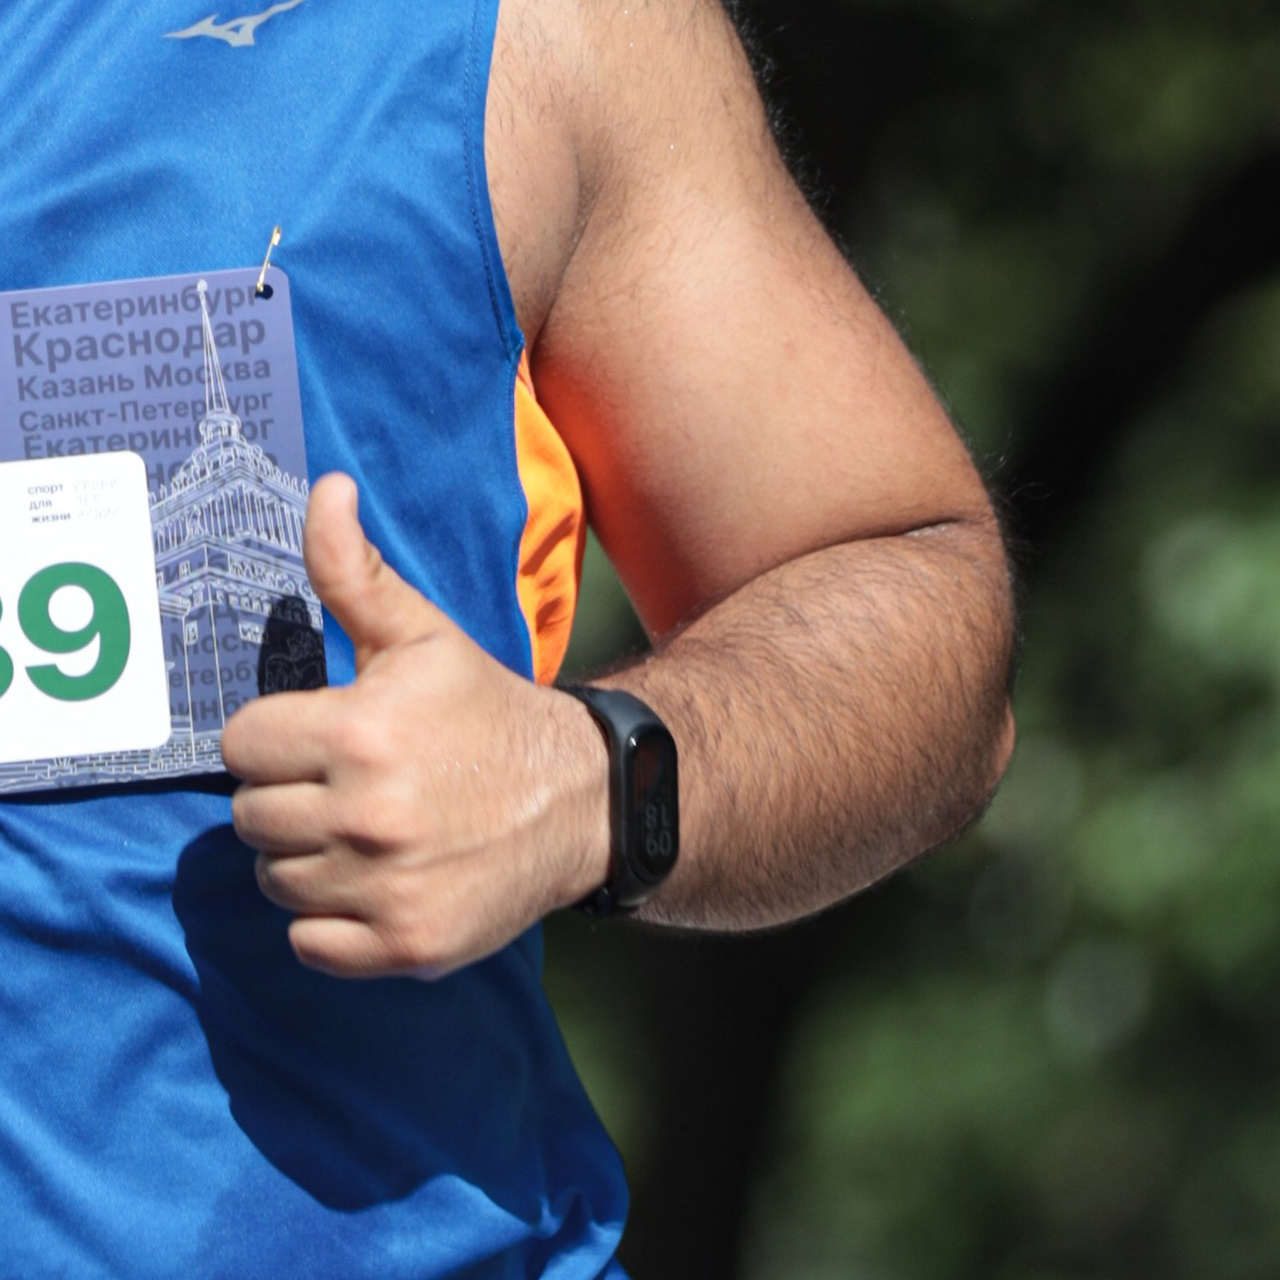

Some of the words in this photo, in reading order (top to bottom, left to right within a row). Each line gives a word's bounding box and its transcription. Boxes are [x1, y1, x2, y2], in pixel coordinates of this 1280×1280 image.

[13, 319, 265, 373] Краснодар
[18, 373, 135, 402] Казань
[144, 359, 271, 390] Москва
[27, 484, 64, 495] спорт
